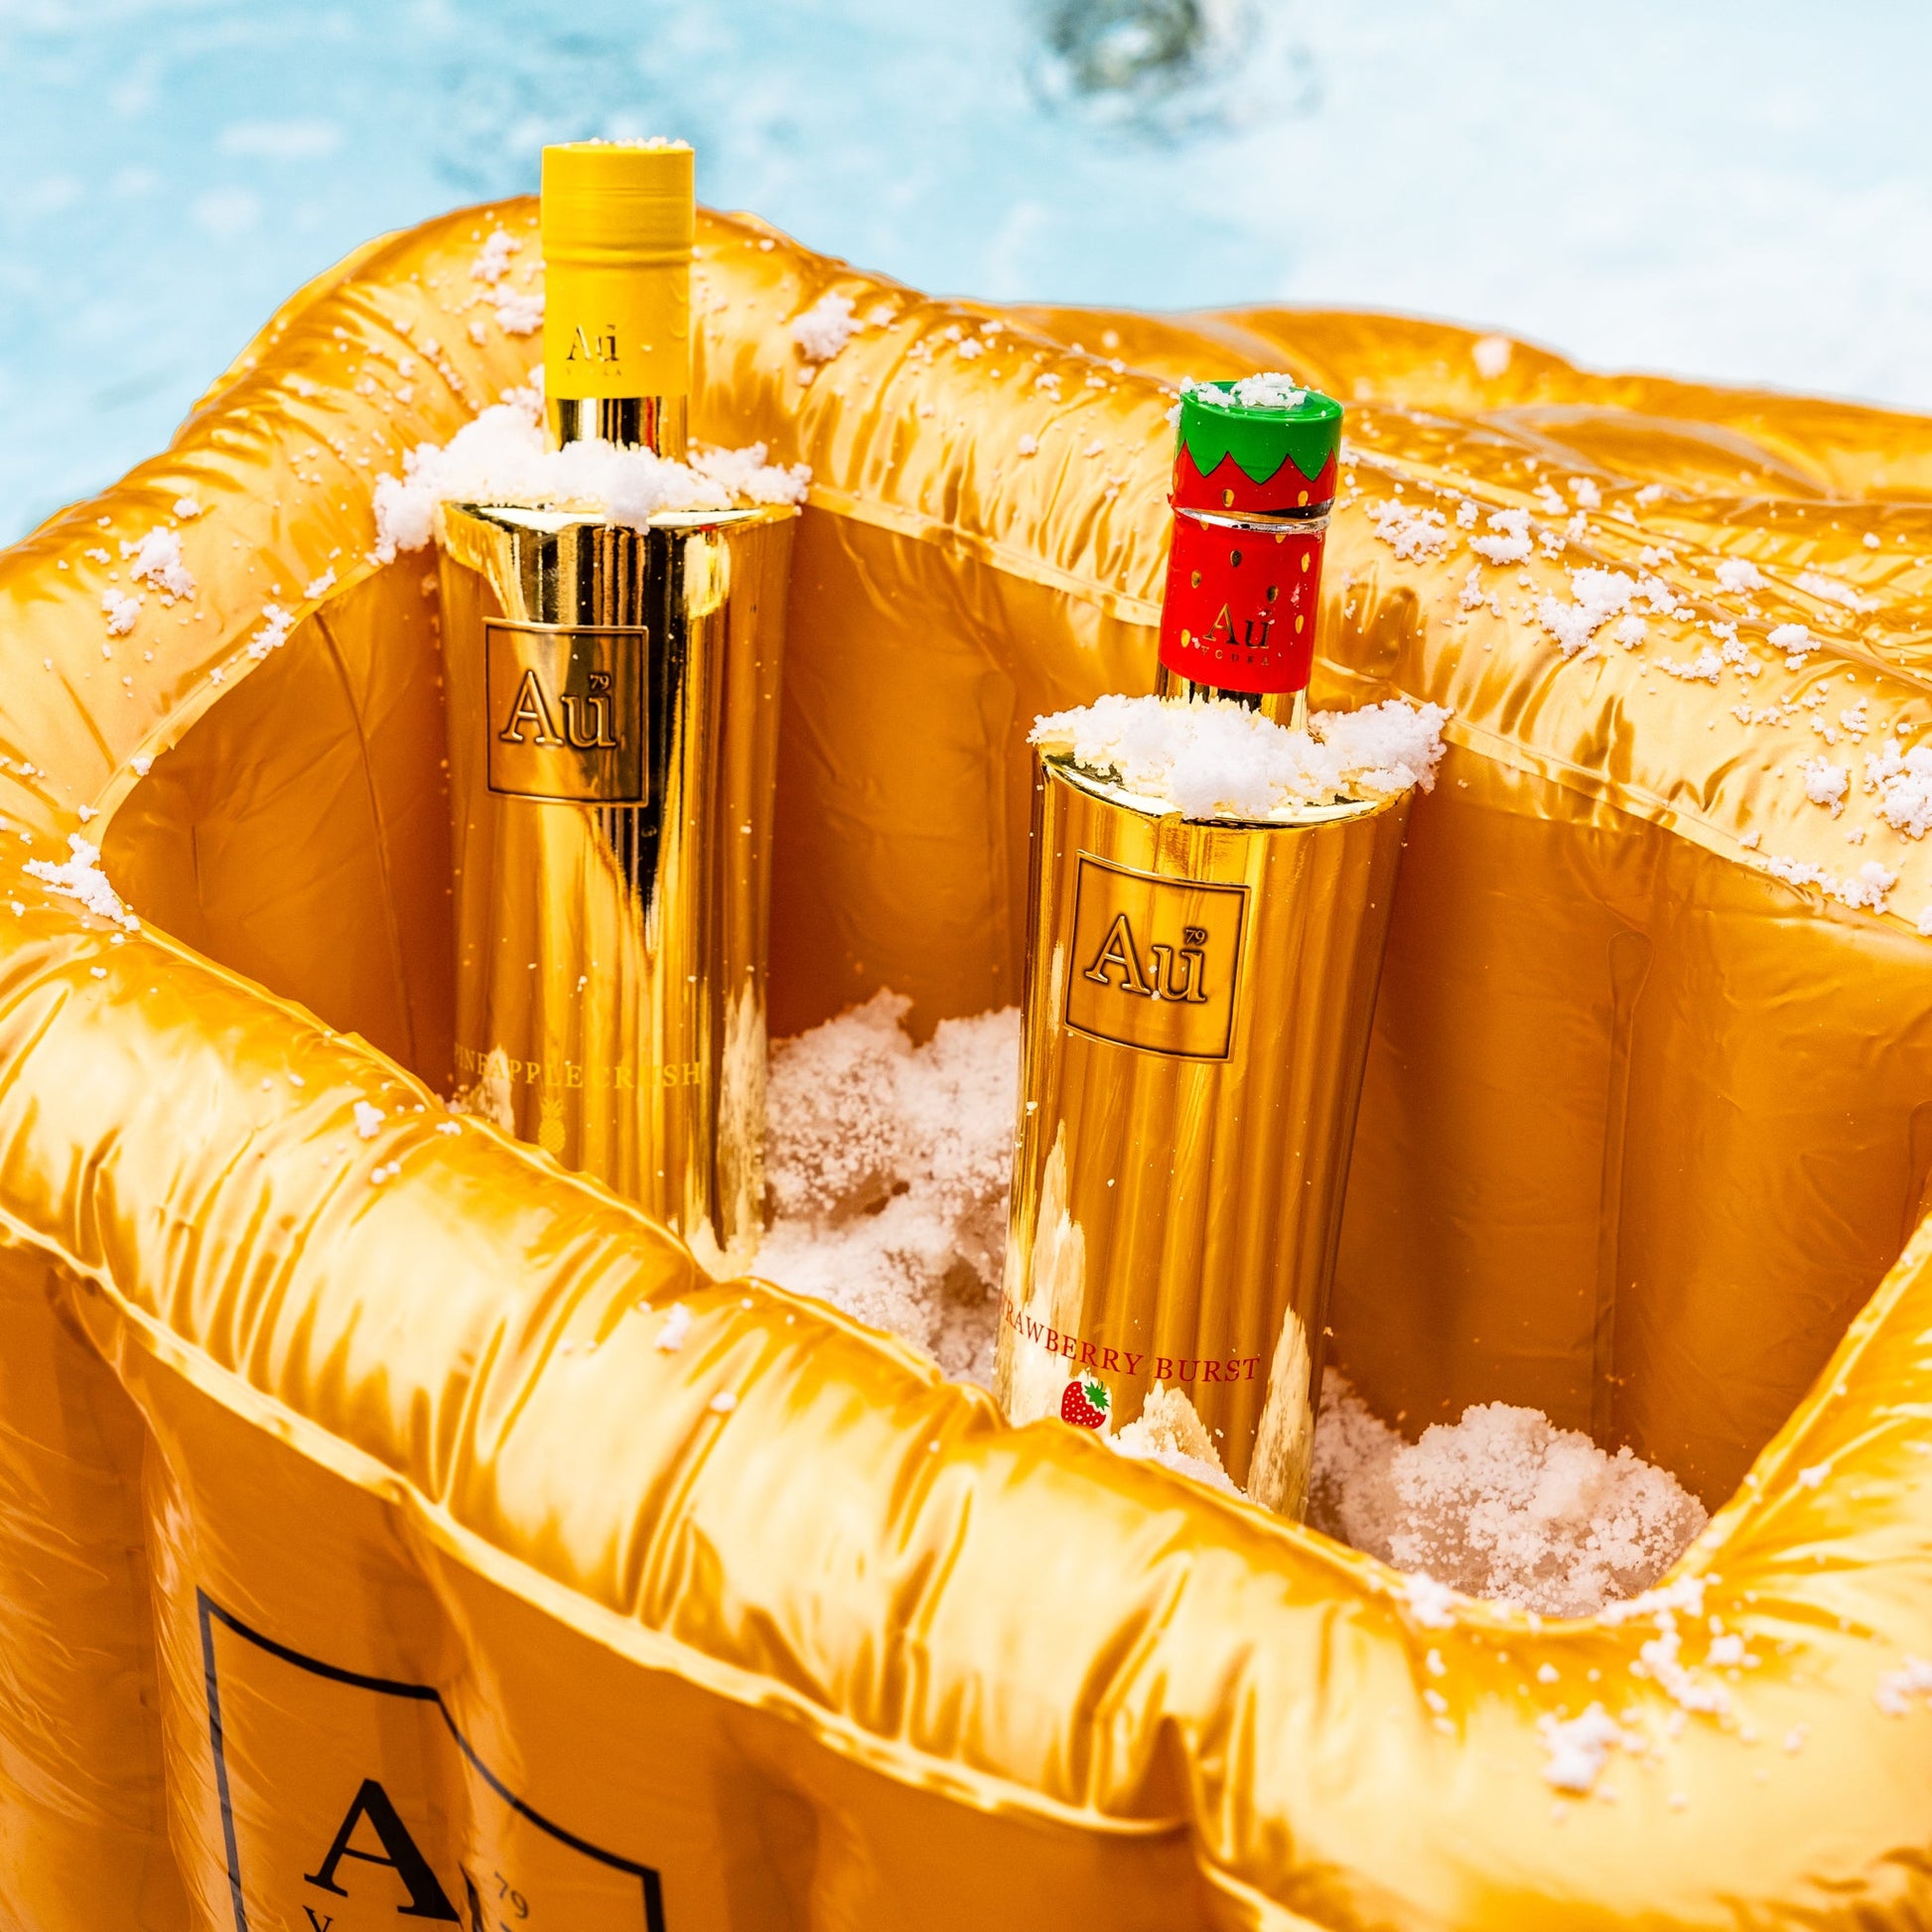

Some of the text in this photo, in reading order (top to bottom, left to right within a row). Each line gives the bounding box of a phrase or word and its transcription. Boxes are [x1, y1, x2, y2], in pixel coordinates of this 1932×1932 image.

[1202, 602, 1270, 649] Au
[589, 673, 611, 692] 79
[499, 669, 618, 750] Au
[1184, 927, 1207, 946] 79
[1084, 913, 1207, 1004] Au
[1155, 1356, 1261, 1382] BURST
